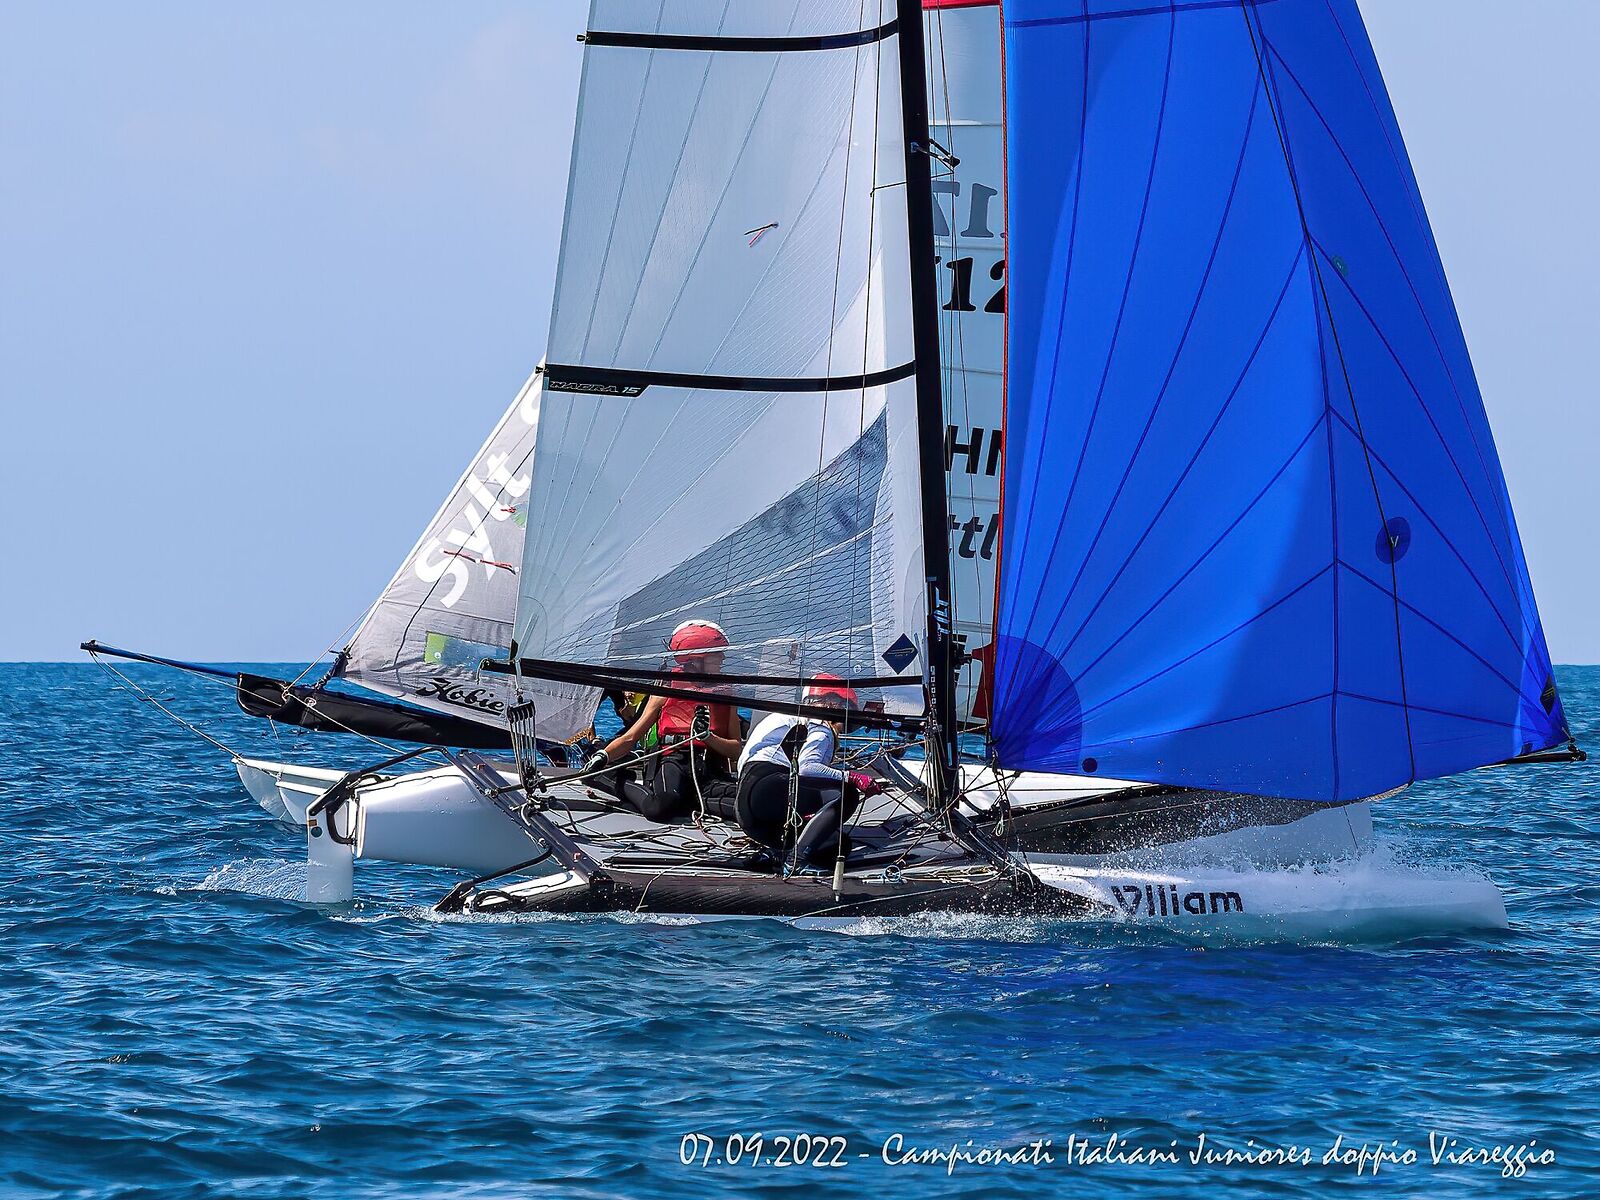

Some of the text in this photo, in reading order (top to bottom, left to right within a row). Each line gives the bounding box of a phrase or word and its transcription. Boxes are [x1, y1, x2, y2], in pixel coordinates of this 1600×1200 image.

[934, 256, 1005, 313] 12
[622, 386, 641, 394] 15
[414, 451, 531, 608] Sylt
[416, 677, 505, 716] Hobie
